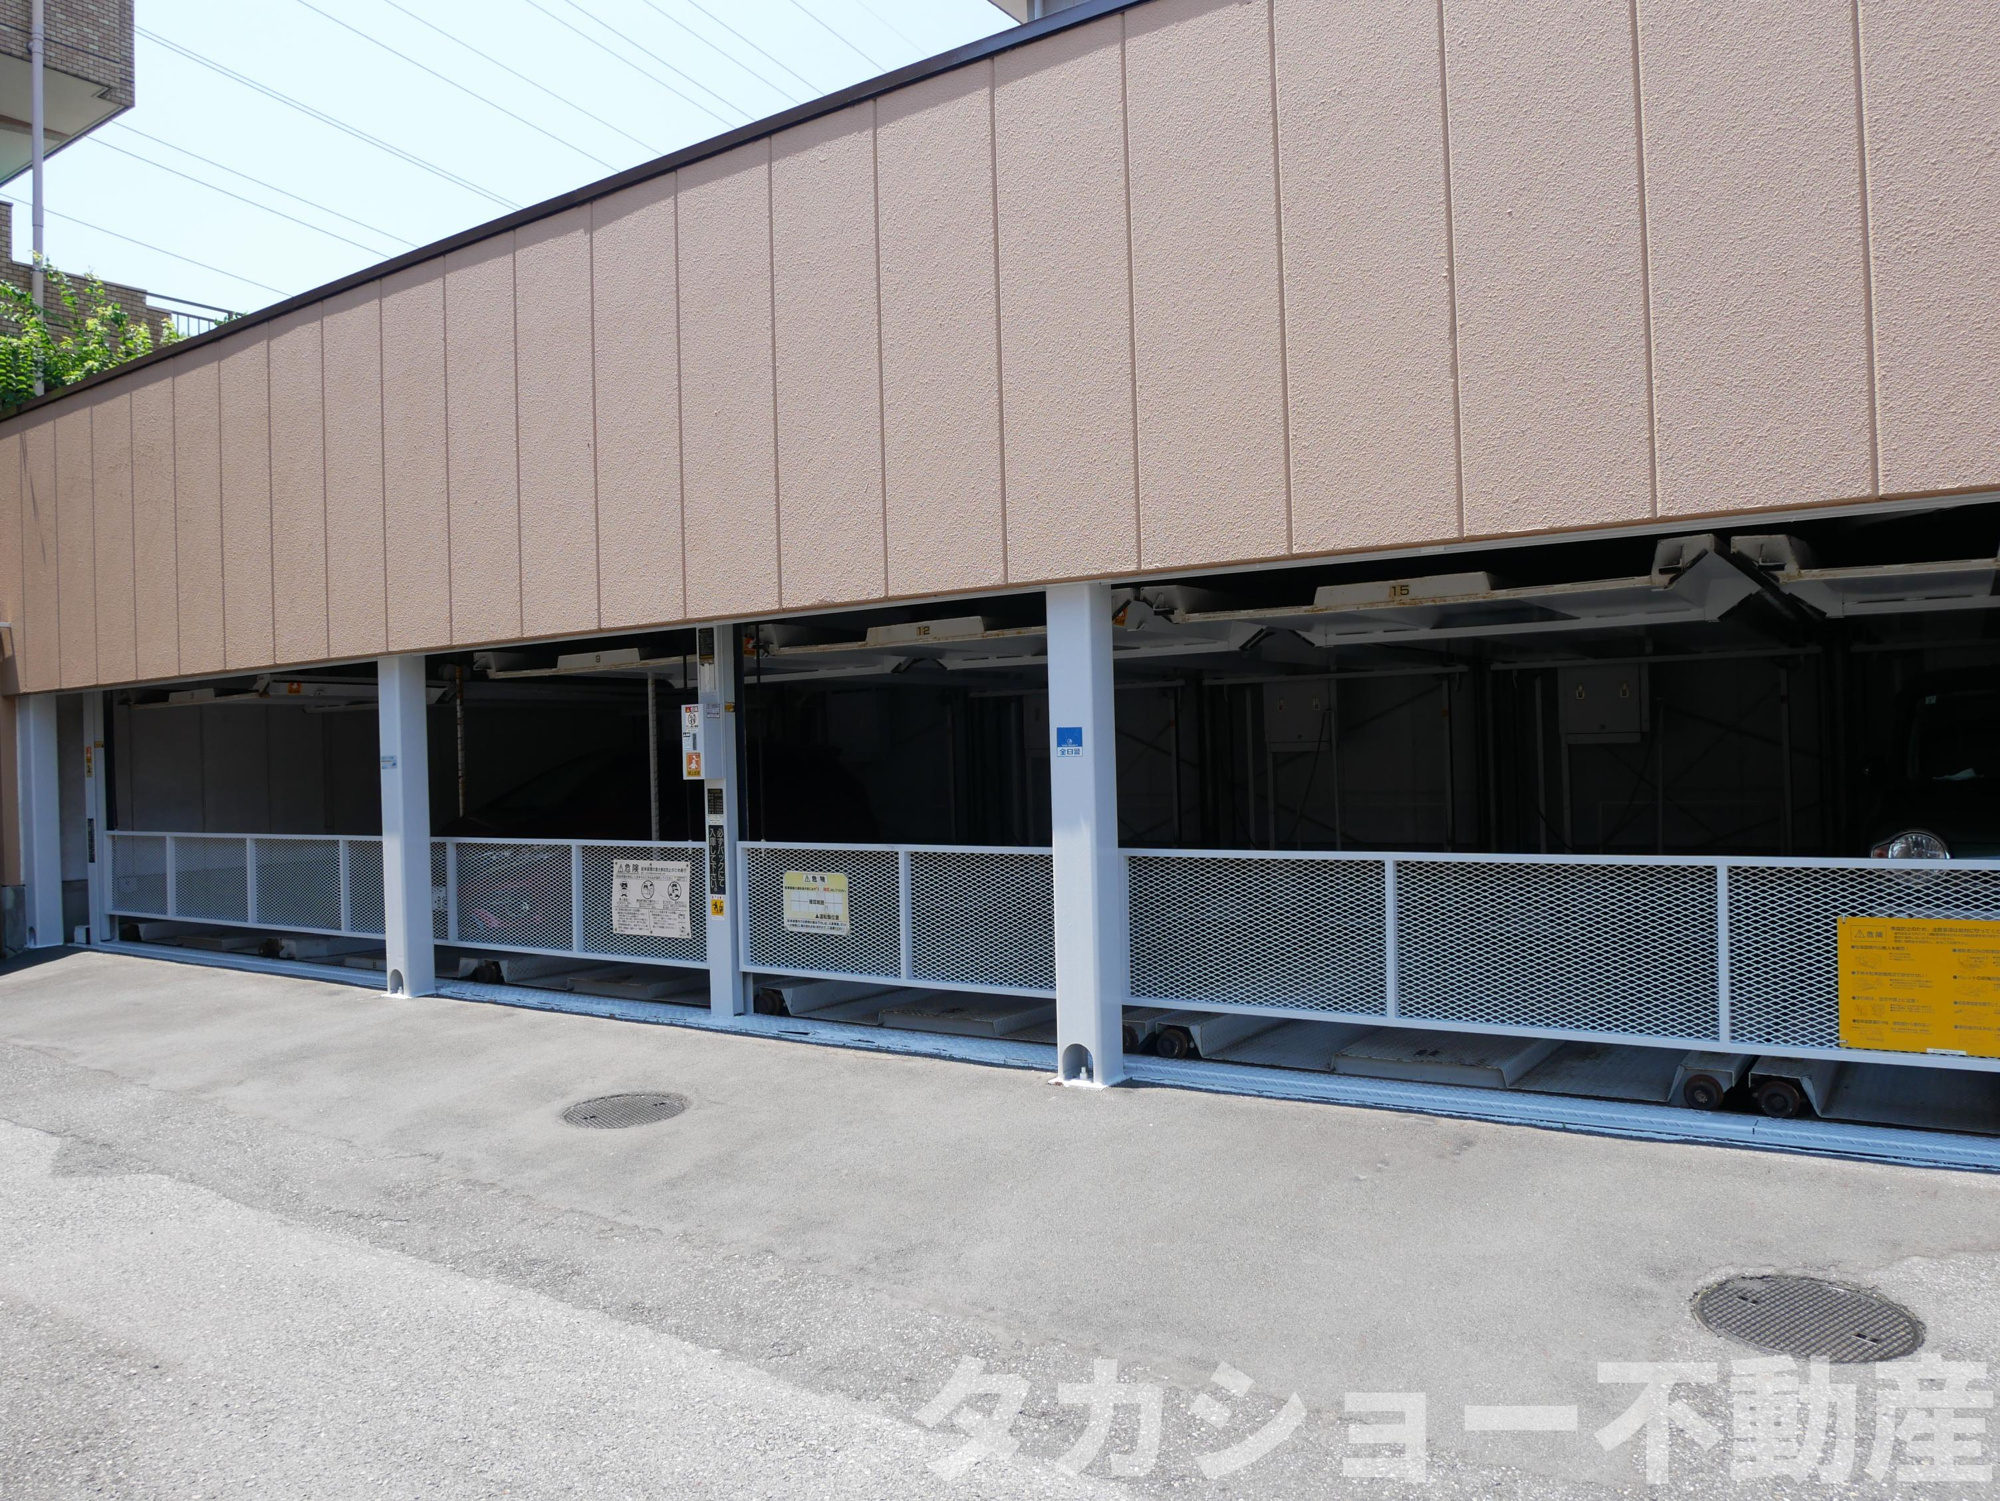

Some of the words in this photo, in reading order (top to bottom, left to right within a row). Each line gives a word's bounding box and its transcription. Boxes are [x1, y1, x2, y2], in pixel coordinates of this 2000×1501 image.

[1391, 585, 1410, 596] 15
[917, 626, 930, 635] 12
[709, 828, 718, 892] 入庫して下さい。
[716, 828, 725, 888] 必ずバックにて
[624, 863, 640, 873] 危険
[811, 875, 826, 883] 危険
[1866, 931, 1884, 939] 危険
